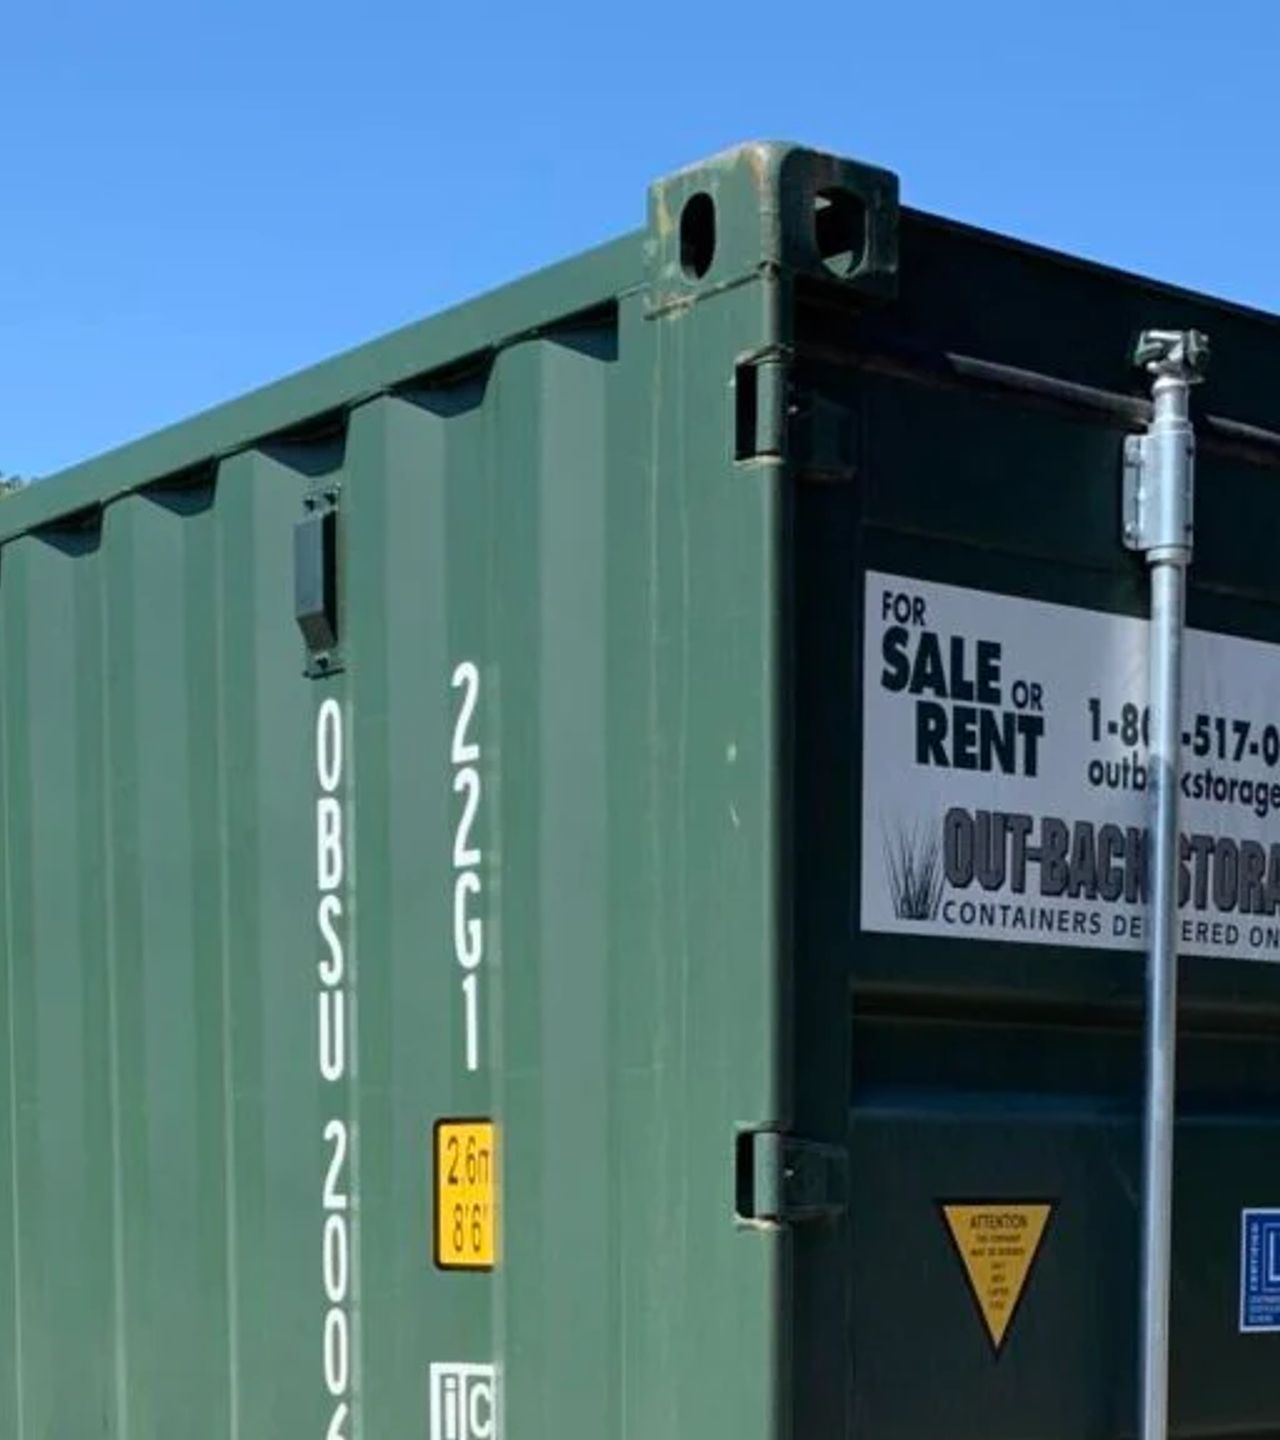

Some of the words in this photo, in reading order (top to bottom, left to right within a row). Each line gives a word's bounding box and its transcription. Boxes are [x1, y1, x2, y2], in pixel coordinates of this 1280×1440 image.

[881, 590, 925, 626] FOR
[880, 626, 1001, 705] SALE
[1011, 679, 1044, 711] OR
[915, 700, 1044, 778] RENT
[317, 698, 344, 1082] OBSU
[451, 662, 482, 1071] 22G1
[943, 900, 1102, 935] CONTAINERS
[1112, 914, 1239, 946] DEERED
[1249, 927, 1279, 950] ON
